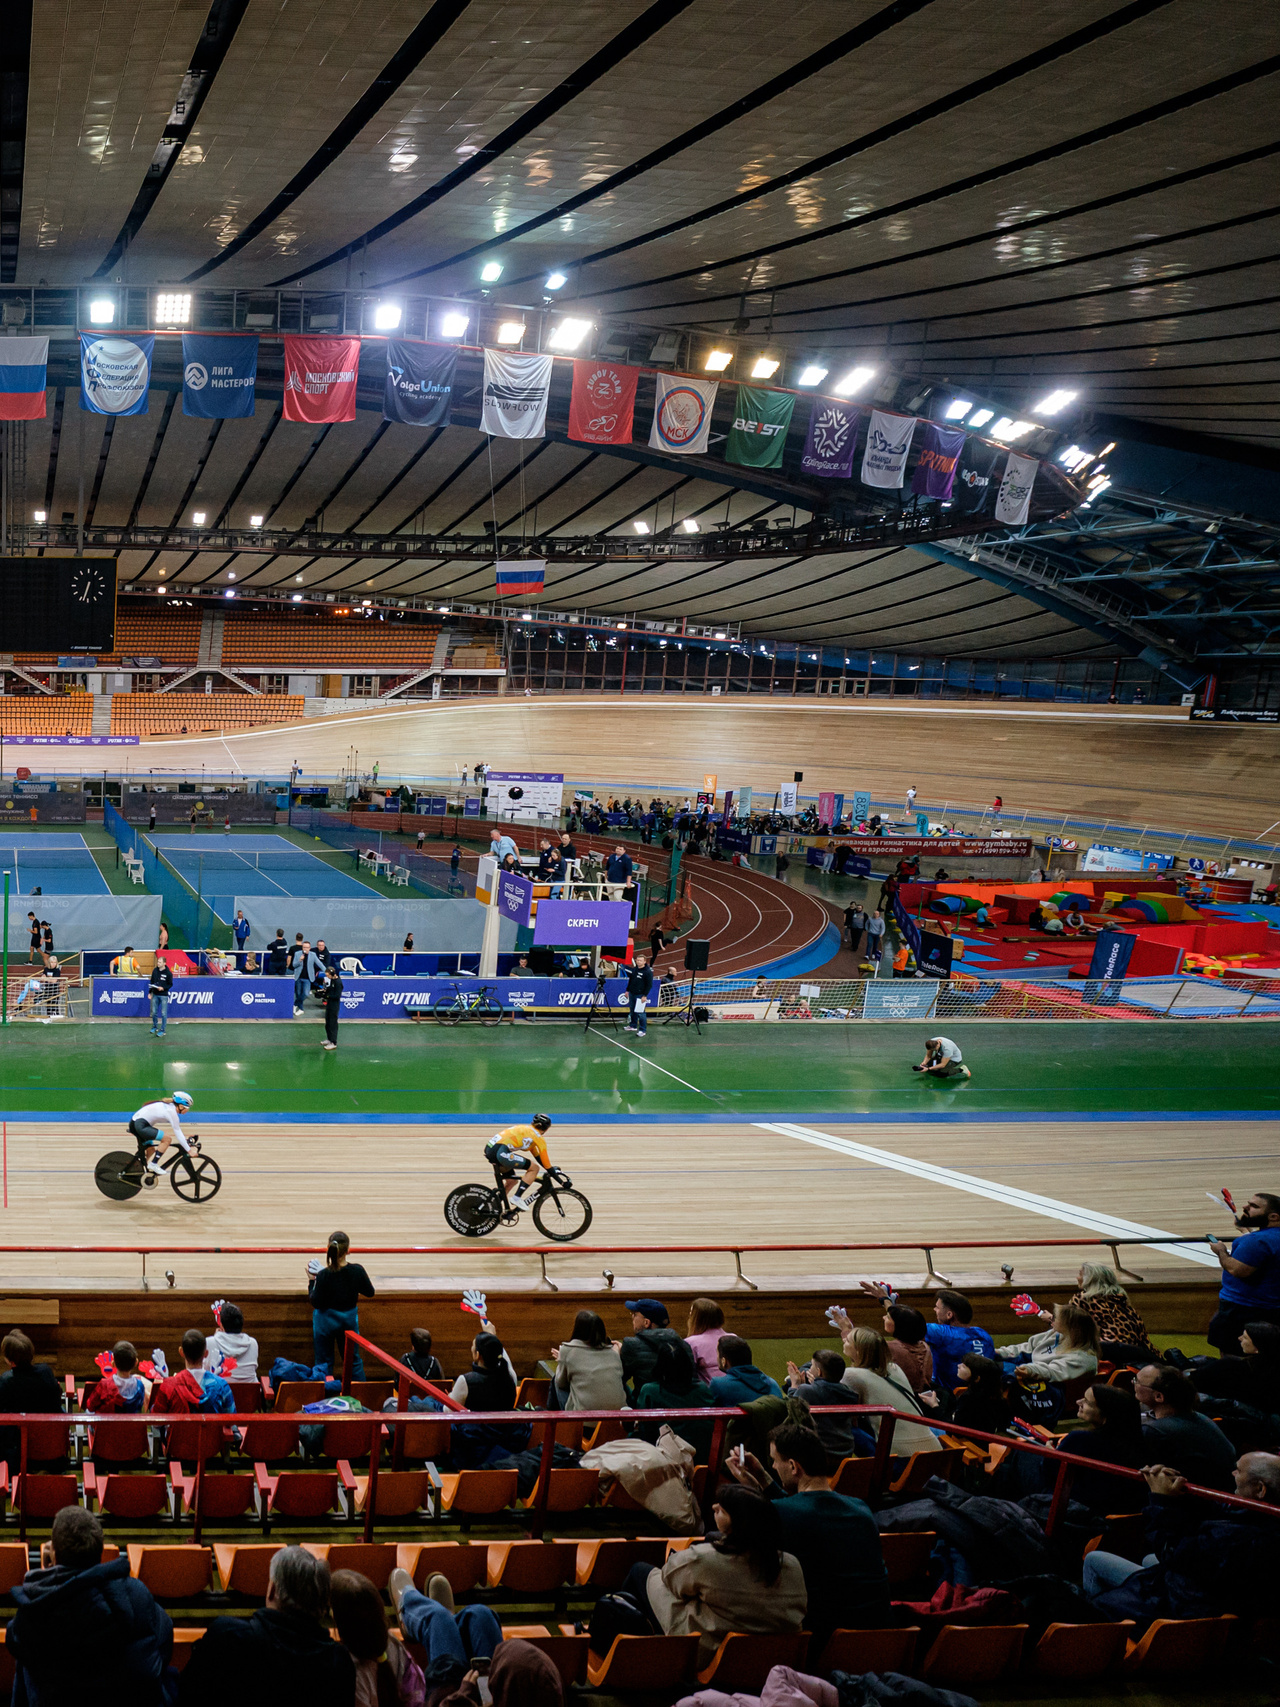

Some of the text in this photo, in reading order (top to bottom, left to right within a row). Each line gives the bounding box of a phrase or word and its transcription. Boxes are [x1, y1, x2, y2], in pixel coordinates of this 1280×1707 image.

[211, 366, 233, 376] ЛИГА
[305, 369, 355, 383] МОСКОВСКИЙ
[211, 376, 255, 388] МАСТЕРОВ
[304, 383, 329, 395] СПОРТ
[923, 840, 939, 848] для
[940, 840, 961, 848] детей
[964, 840, 1028, 849] www.gymbaby.ru
[567, 918, 599, 928] СКРЕТЧ
[1104, 942, 1120, 980] TeleRace
[381, 992, 431, 1005] SPUTNIK
[557, 992, 606, 1005] SPUTNIK
